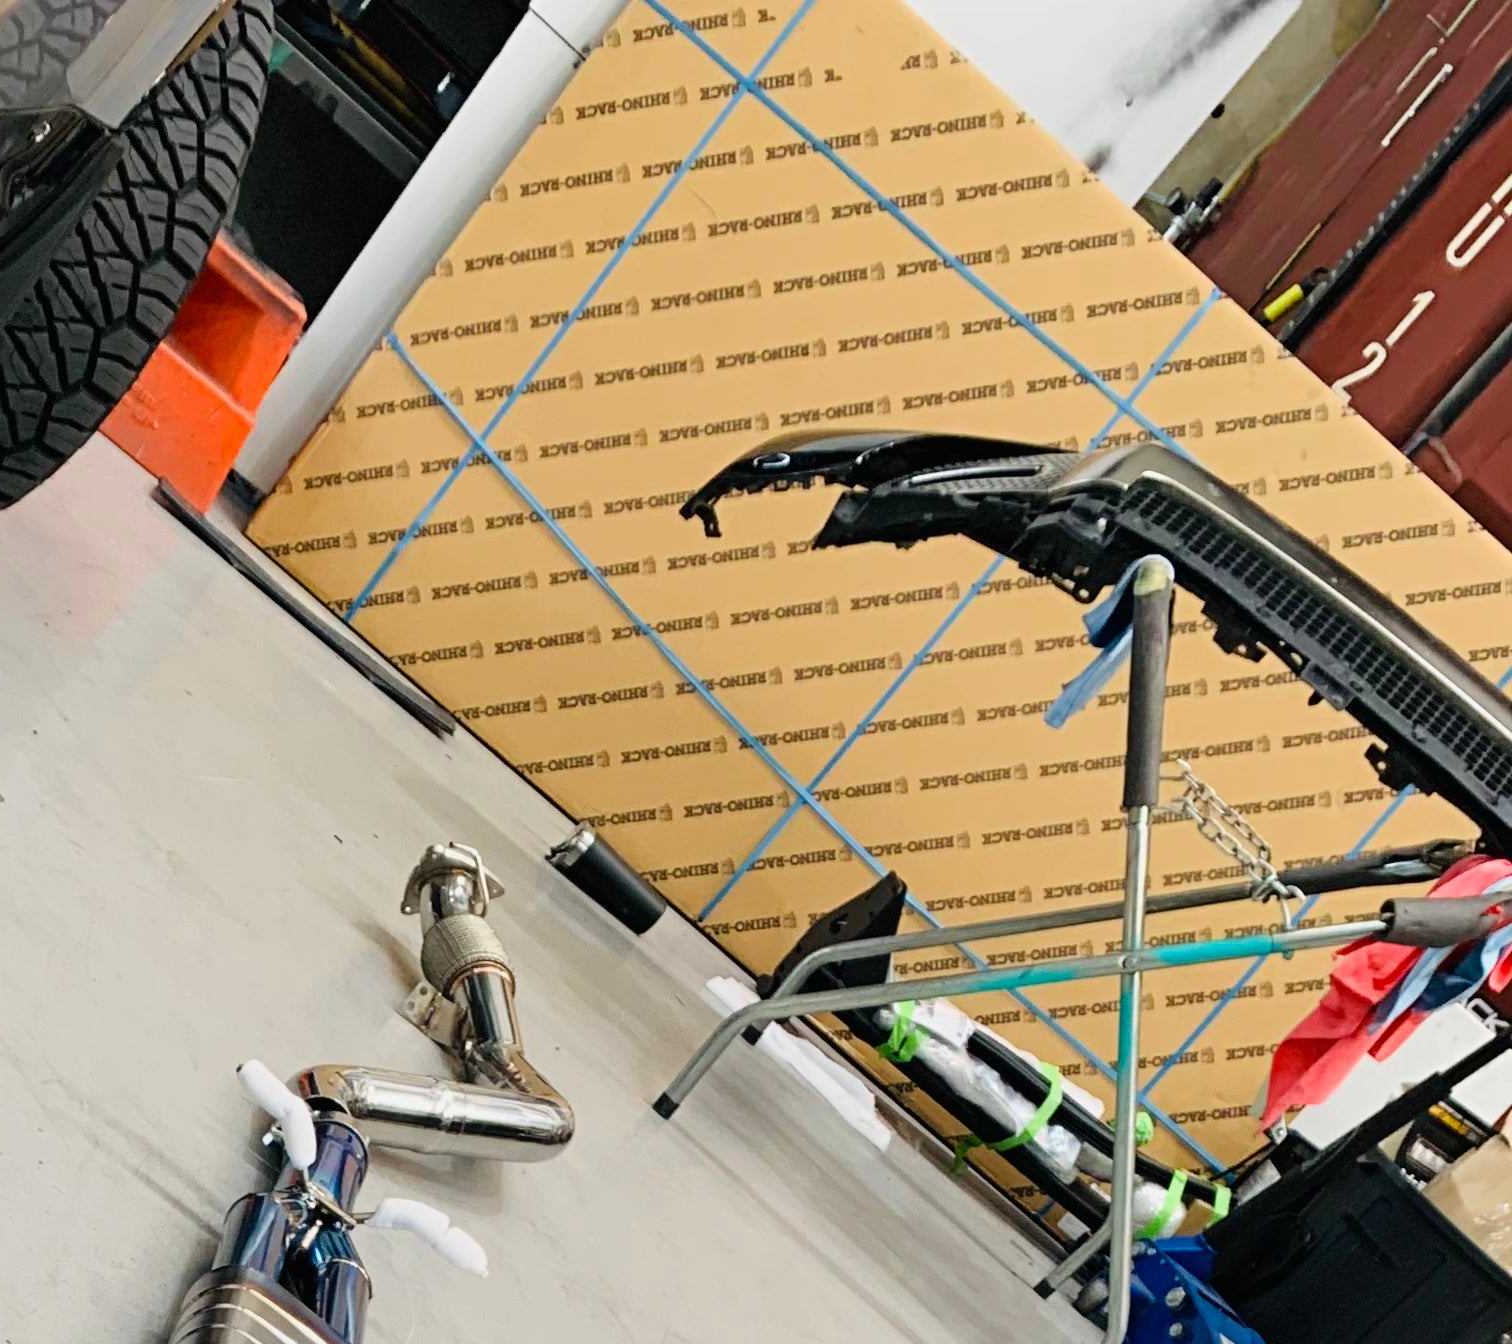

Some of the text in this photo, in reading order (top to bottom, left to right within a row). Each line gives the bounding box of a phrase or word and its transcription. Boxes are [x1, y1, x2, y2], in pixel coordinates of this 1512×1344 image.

[575, 91, 671, 119] RHINO-RACK
[889, 113, 988, 142] RHINO-RACK
[519, 168, 614, 196] RHINO-RACK
[955, 173, 1053, 201] RHINO-RACK
[707, 209, 803, 236] RHINO-RACK
[464, 244, 558, 271] RHINO-RACK
[1020, 232, 1119, 260] RHINO-RACK
[772, 267, 868, 294] RHINO-RACK
[650, 284, 745, 311] RHINO-RACK
[1085, 291, 1184, 318] RHINO-RACK
[410, 318, 503, 345] RHINO-RACK
[837, 325, 933, 352] RHINO-RACK
[715, 342, 810, 369] RHINO-RACK
[594, 359, 688, 385] RHINO-RACK
[901, 383, 998, 410] RHINO-RACK
[779, 399, 875, 426] RHINO-RACK
[1214, 407, 1313, 434] RHINO-RACK
[658, 416, 753, 442] RHINO-RACK
[539, 432, 632, 458] RHINO-RACK
[304, 464, 395, 489] RHINO-RACK
[1278, 465, 1377, 492] RHINO-RACK
[1341, 523, 1440, 549] RHINO-RACK
[667, 545, 760, 570] RHINO-RACK
[431, 575, 523, 600] RHINO-RACK
[850, 585, 944, 610] RHINO-RACK
[1404, 580, 1504, 606] RHINO-RACK
[730, 600, 824, 625] RHINO-RACK
[495, 630, 586, 655] RHINO-RACK
[793, 656, 887, 681] RHINO-RACK
[558, 685, 649, 709] RHINO-RACK
[620, 740, 712, 764] RHINO-RACK
[918, 766, 1012, 790] RHINO-RACK
[683, 794, 774, 818] RHINO-RACK
[981, 821, 1074, 845] RHINO-RACK
[924, 889, 1017, 912] RHINO-RACK
[985, 943, 1078, 966] RHINO-RACK
